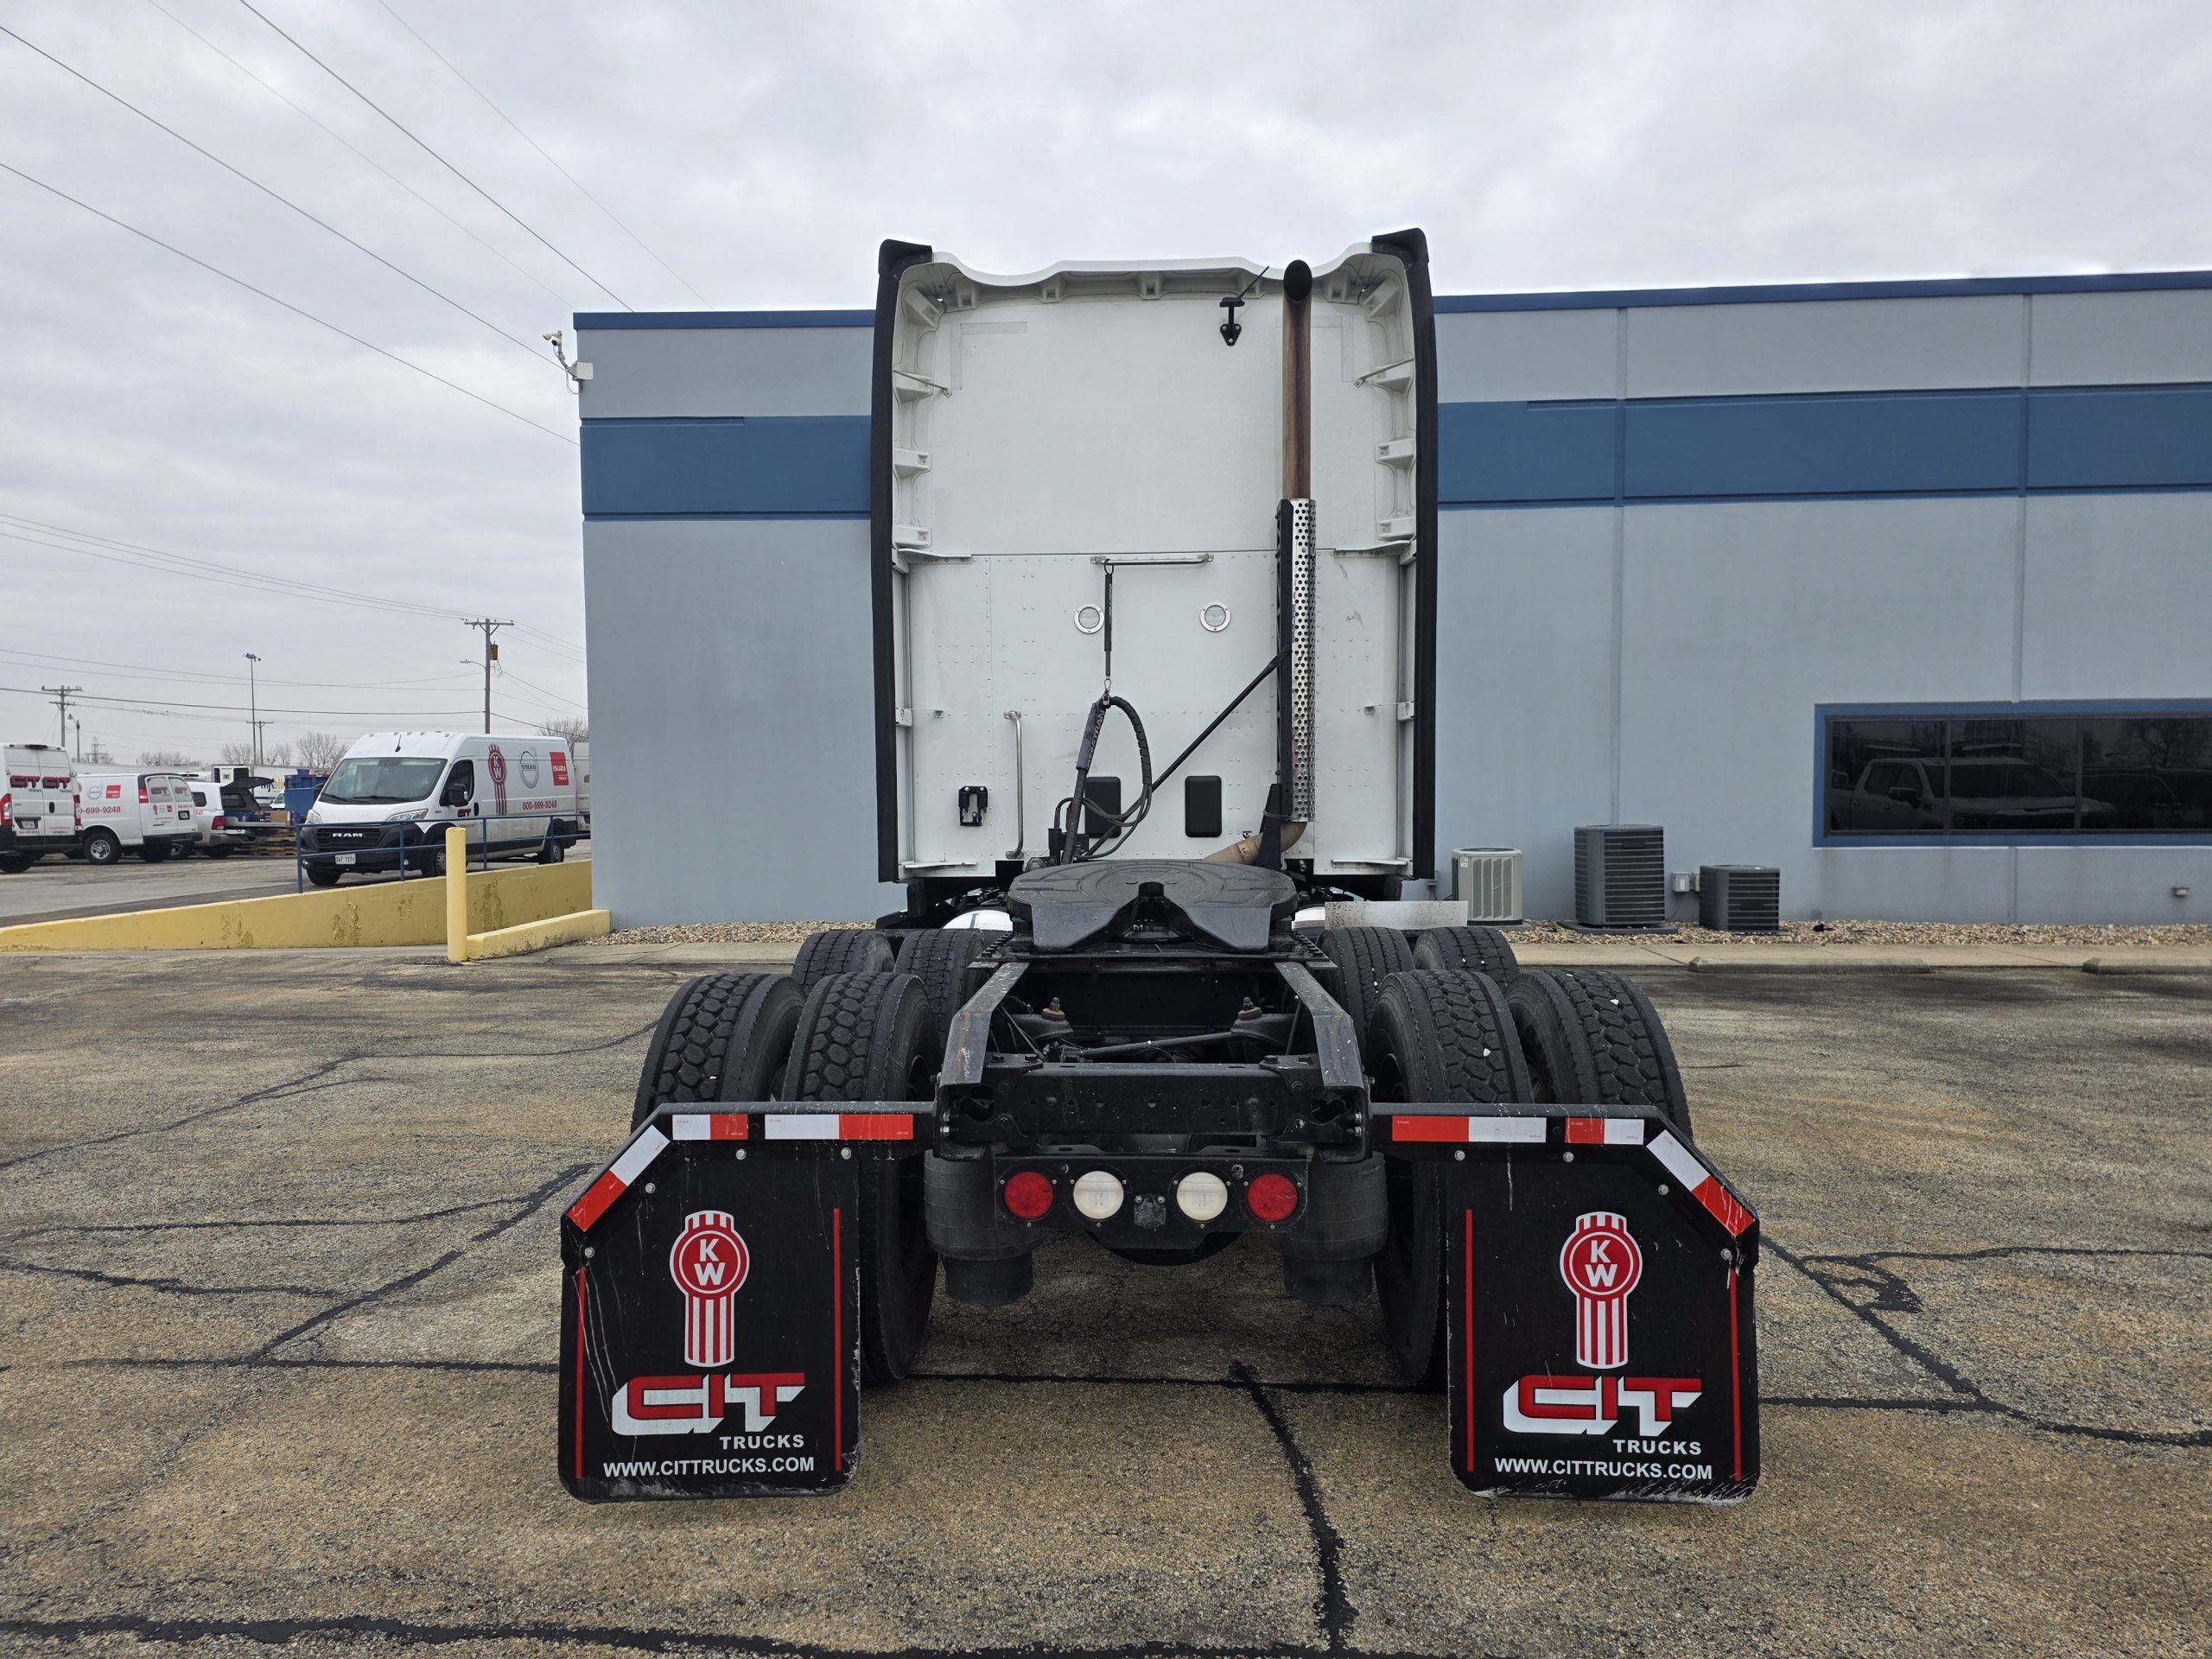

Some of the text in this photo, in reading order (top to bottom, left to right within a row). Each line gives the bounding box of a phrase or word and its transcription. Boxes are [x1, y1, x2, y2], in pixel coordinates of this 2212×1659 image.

[522, 800, 557, 810] 800-699-9248
[612, 1373, 805, 1435] CIT
[1503, 1375, 1702, 1436] CIT
[719, 1434, 804, 1450] TRUCKS
[1612, 1439, 1702, 1455] TRUCKS
[603, 1457, 815, 1478] WWW.CITTRUCKS.COM
[1495, 1458, 1713, 1480] WWW.CITTRUCKS.COM
